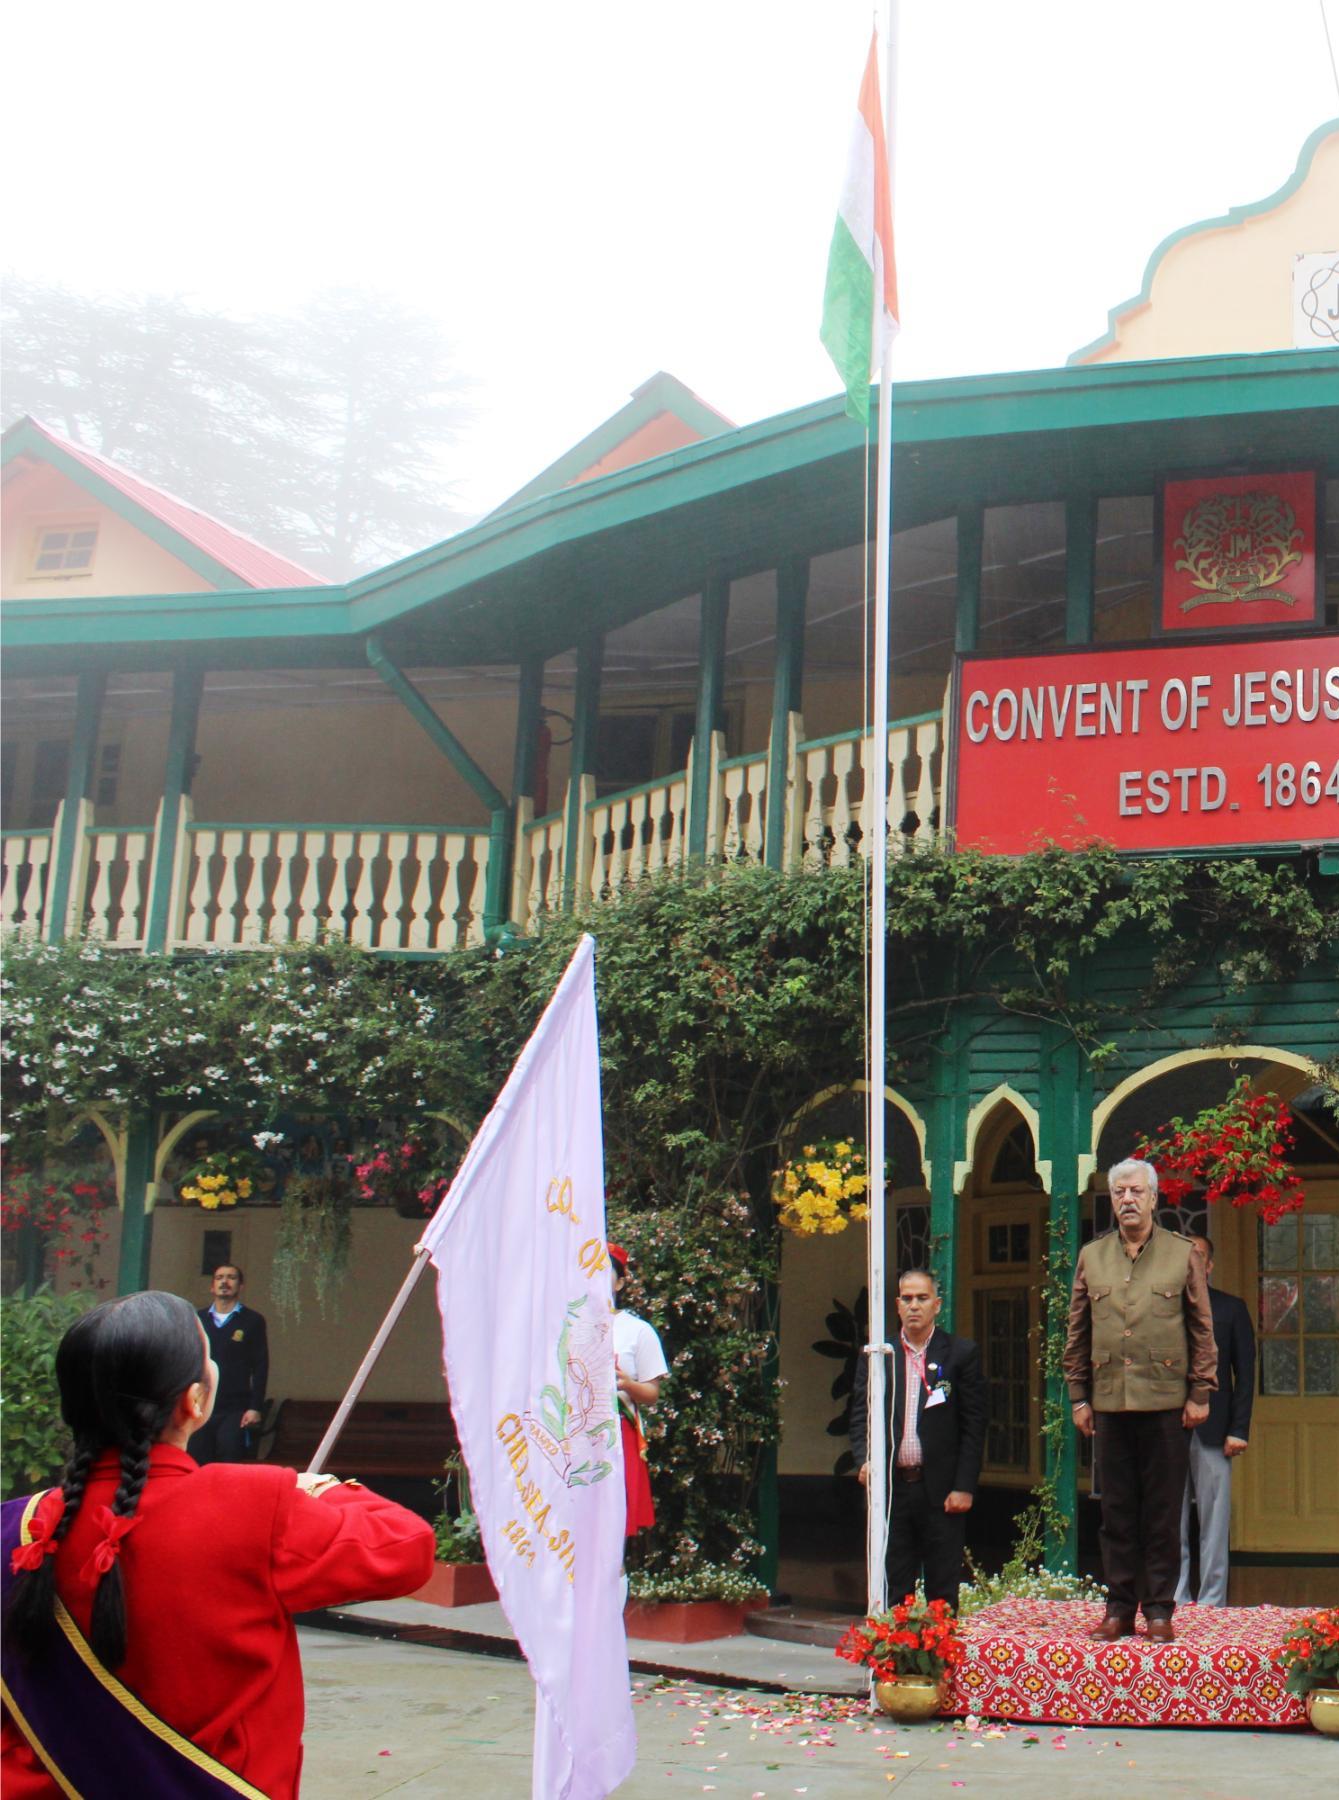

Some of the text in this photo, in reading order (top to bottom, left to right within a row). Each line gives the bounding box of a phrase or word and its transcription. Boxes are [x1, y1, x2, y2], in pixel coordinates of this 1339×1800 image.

[1225, 531, 1253, 559] JM
[965, 679, 1149, 743] CONVENT
[1160, 674, 1212, 731] OF
[1119, 765, 1240, 816] ESTD.
